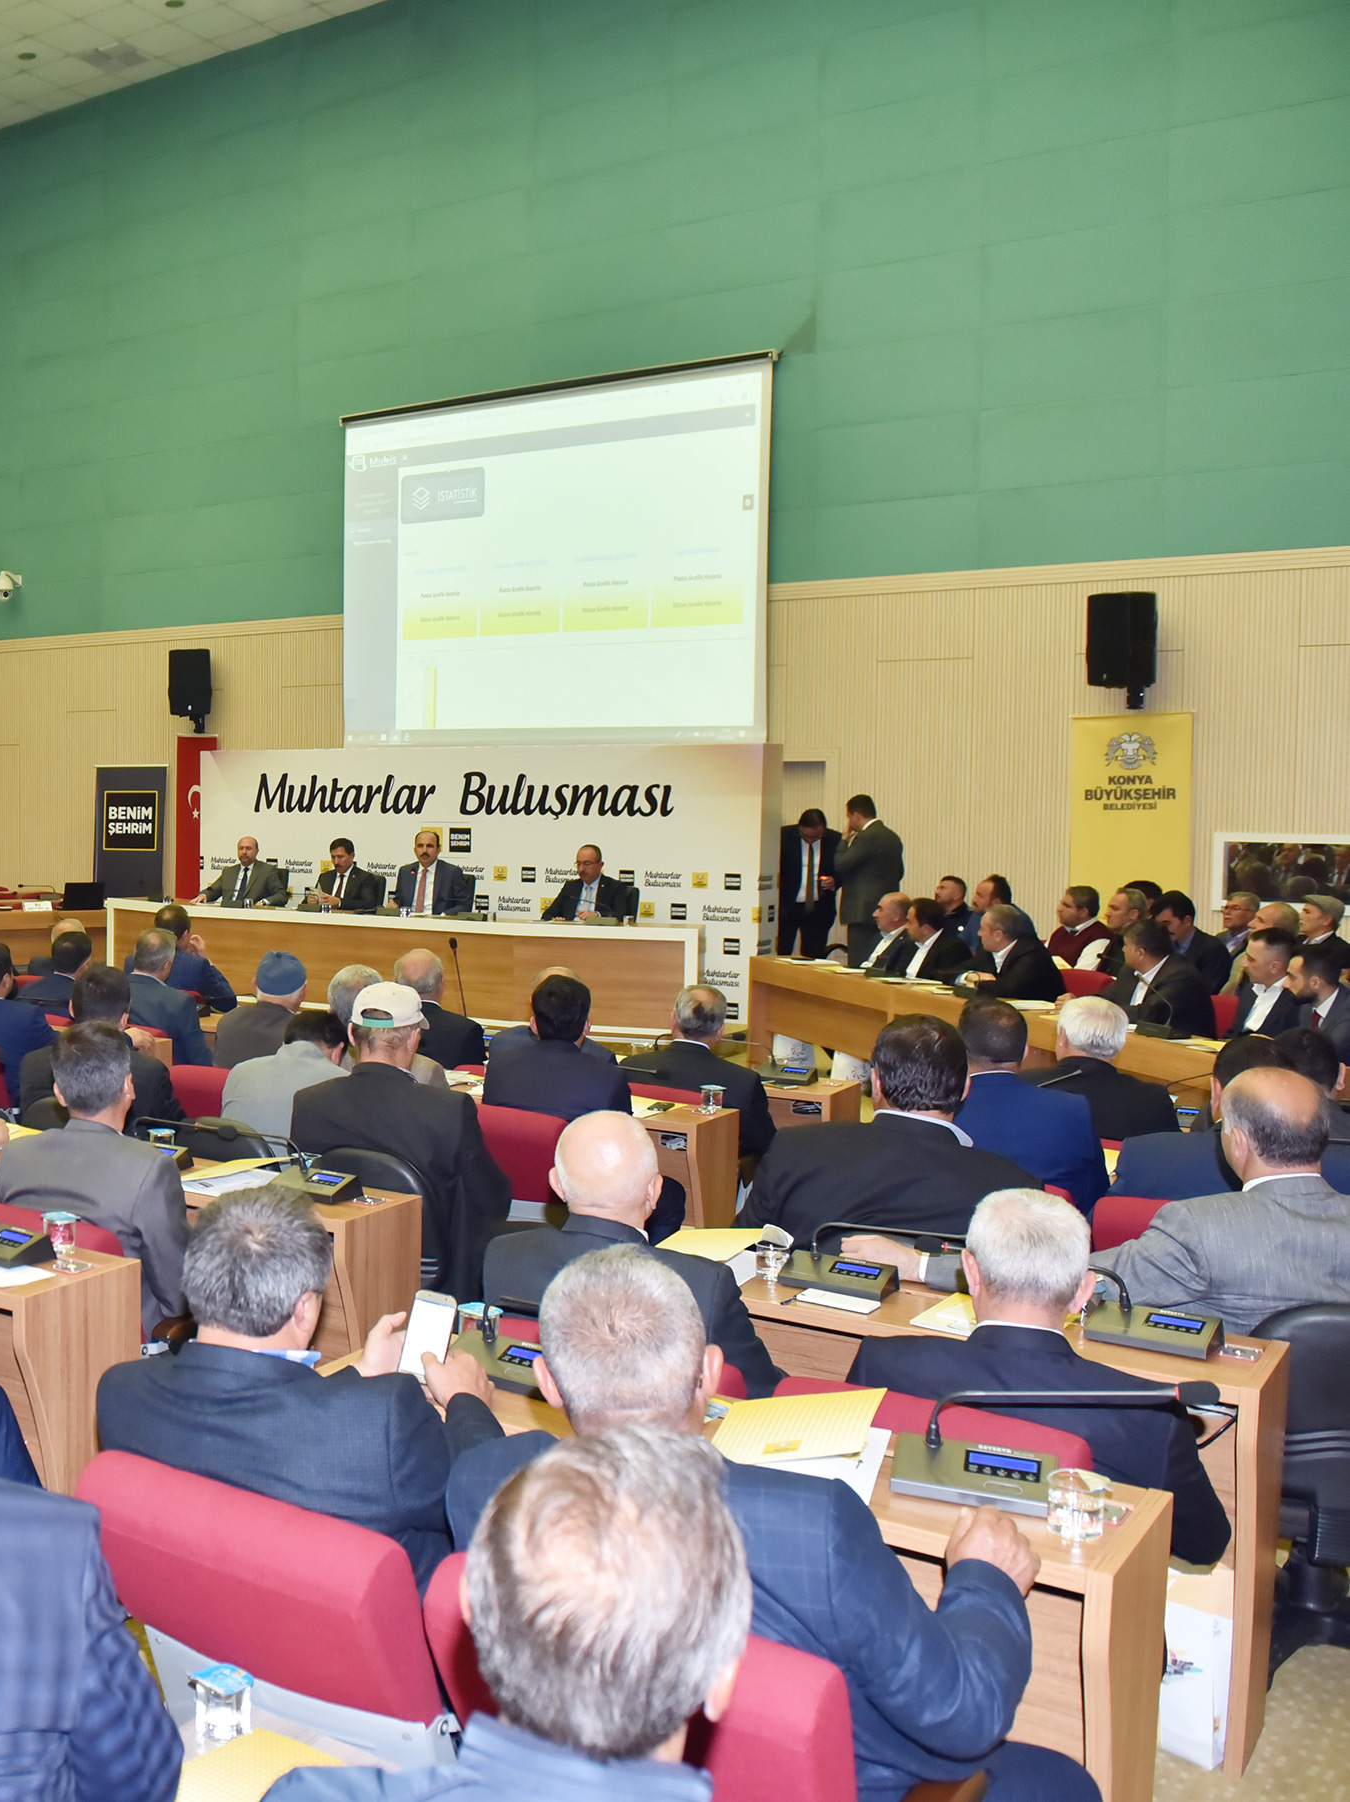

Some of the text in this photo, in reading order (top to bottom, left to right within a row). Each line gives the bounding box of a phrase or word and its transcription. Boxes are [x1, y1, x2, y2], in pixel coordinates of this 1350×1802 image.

[437, 486, 478, 502] İSTATİSTİK
[1108, 775, 1153, 785] KONYA
[254, 771, 674, 820] Muhtarlar Buluşması
[1084, 785, 1176, 802] BÜYÜKŞEHİR
[1103, 801, 1157, 810] BELEDİYESİ
[108, 806, 153, 820] BENİM
[108, 822, 153, 836] ŞEHRİM
[644, 870, 682, 879] Muhtarlar
[644, 878, 682, 888] Buluşması
[498, 896, 531, 904] Muhtarlar
[702, 905, 741, 914] Muhtarlar
[702, 913, 741, 922] Buluşması
